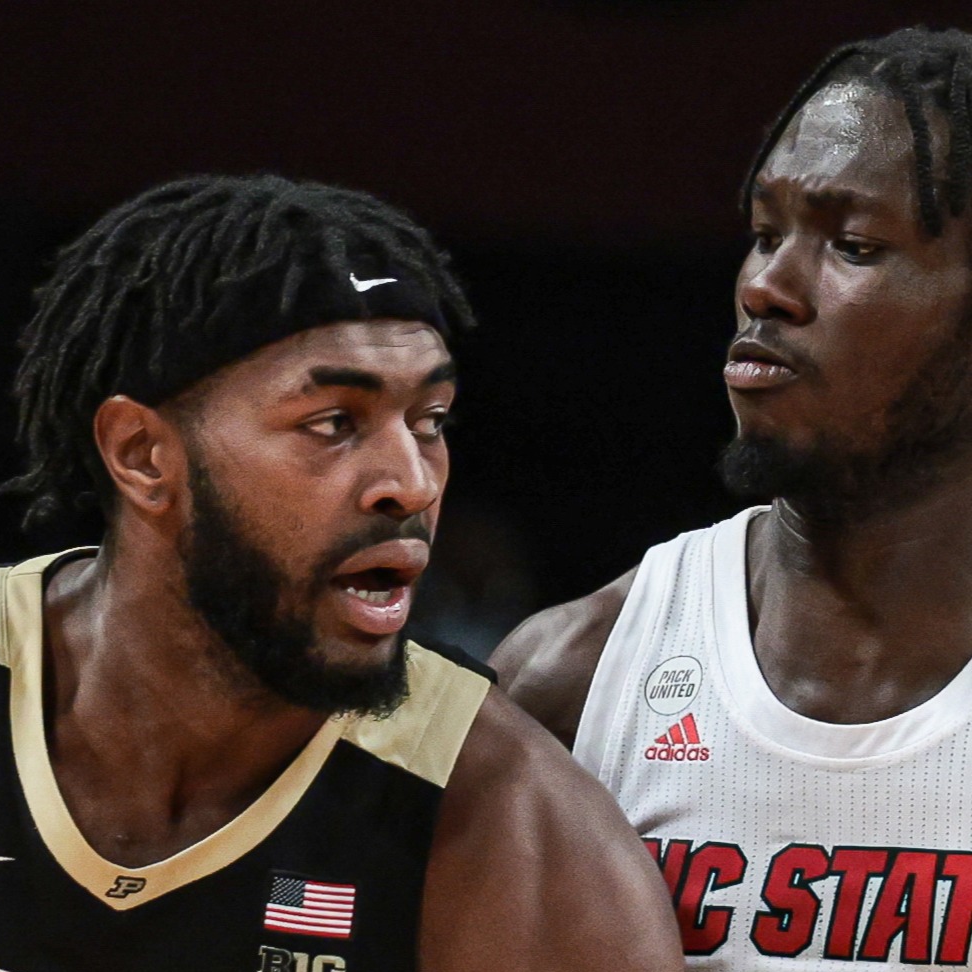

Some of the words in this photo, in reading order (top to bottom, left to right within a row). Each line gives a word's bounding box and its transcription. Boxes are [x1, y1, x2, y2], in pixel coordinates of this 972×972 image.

[658, 669, 695, 685] PACK
[649, 683, 695, 700] UNITED
[644, 743, 710, 762] adidas
